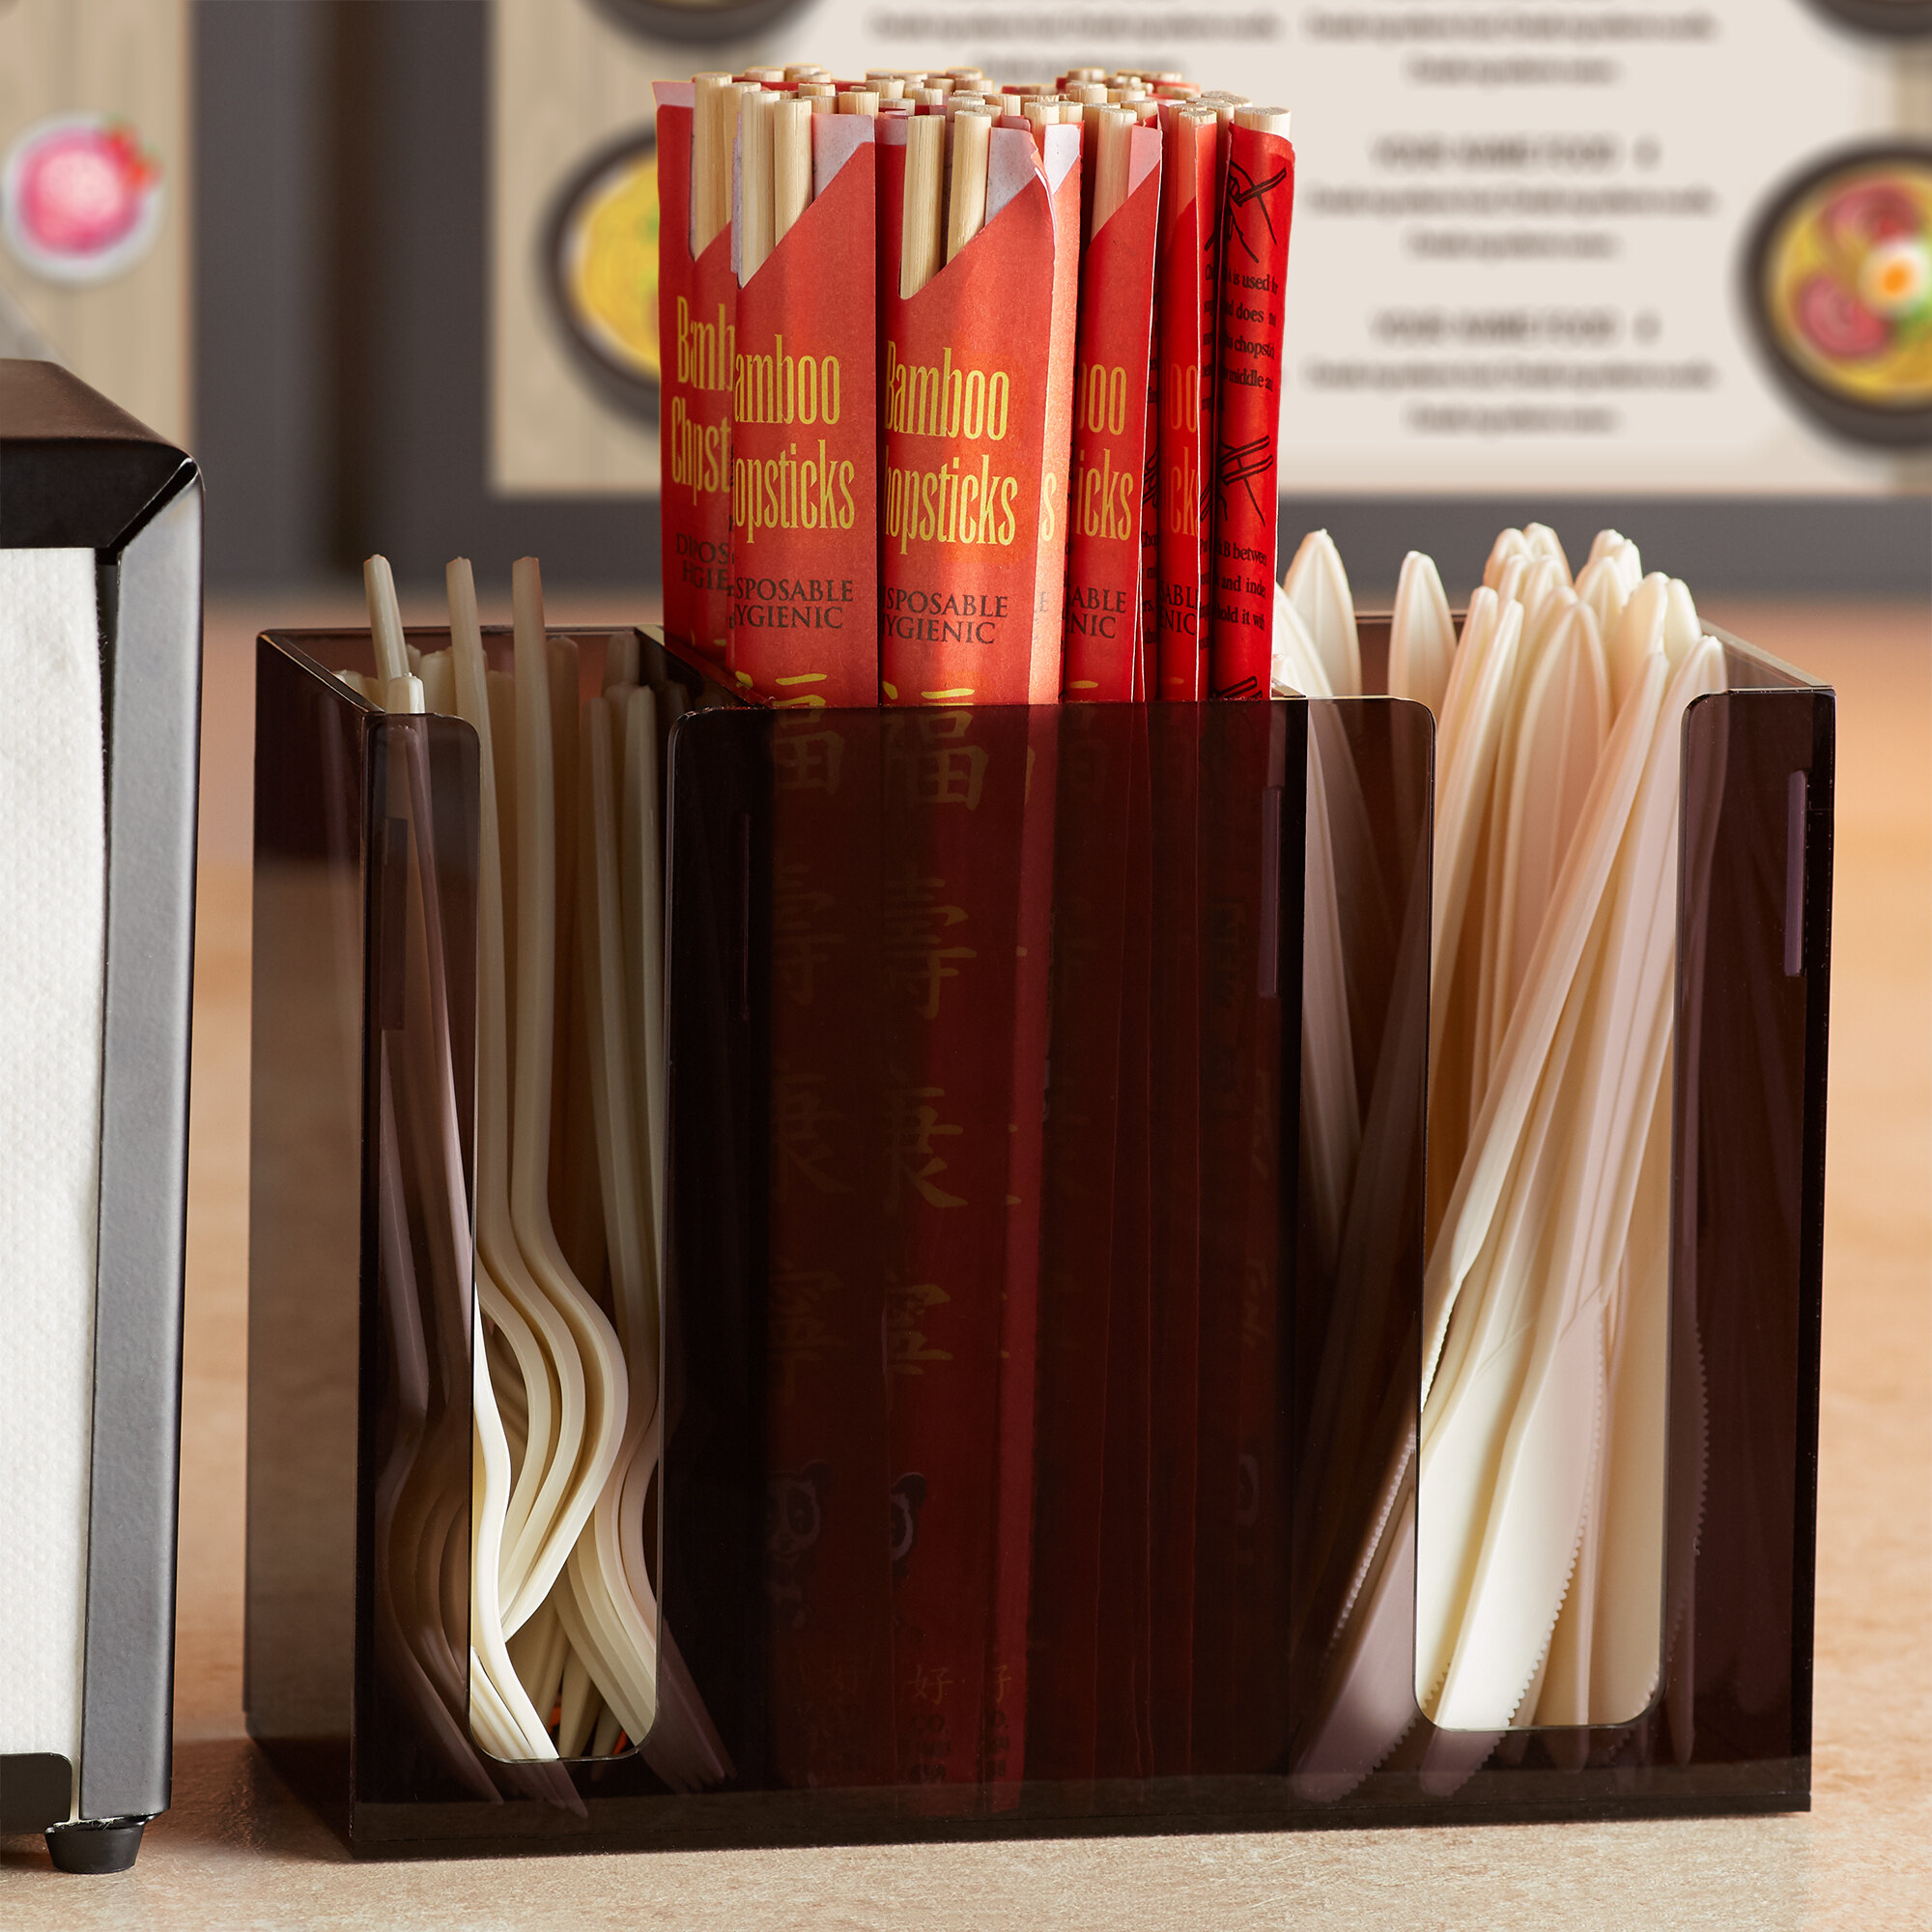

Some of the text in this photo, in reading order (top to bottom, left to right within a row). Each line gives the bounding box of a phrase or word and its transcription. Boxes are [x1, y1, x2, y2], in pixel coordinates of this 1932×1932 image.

[1236, 302, 1264, 323] does
[1242, 274, 1269, 291] used
[735, 334, 840, 425] amboo
[885, 341, 1009, 440] Bamboo
[733, 440, 855, 543] opsticks
[885, 445, 1018, 554] hopsticks
[1076, 448, 1133, 541] icks
[736, 578, 854, 602] SPOSABLE
[881, 586, 1009, 618] ISPOSABLE
